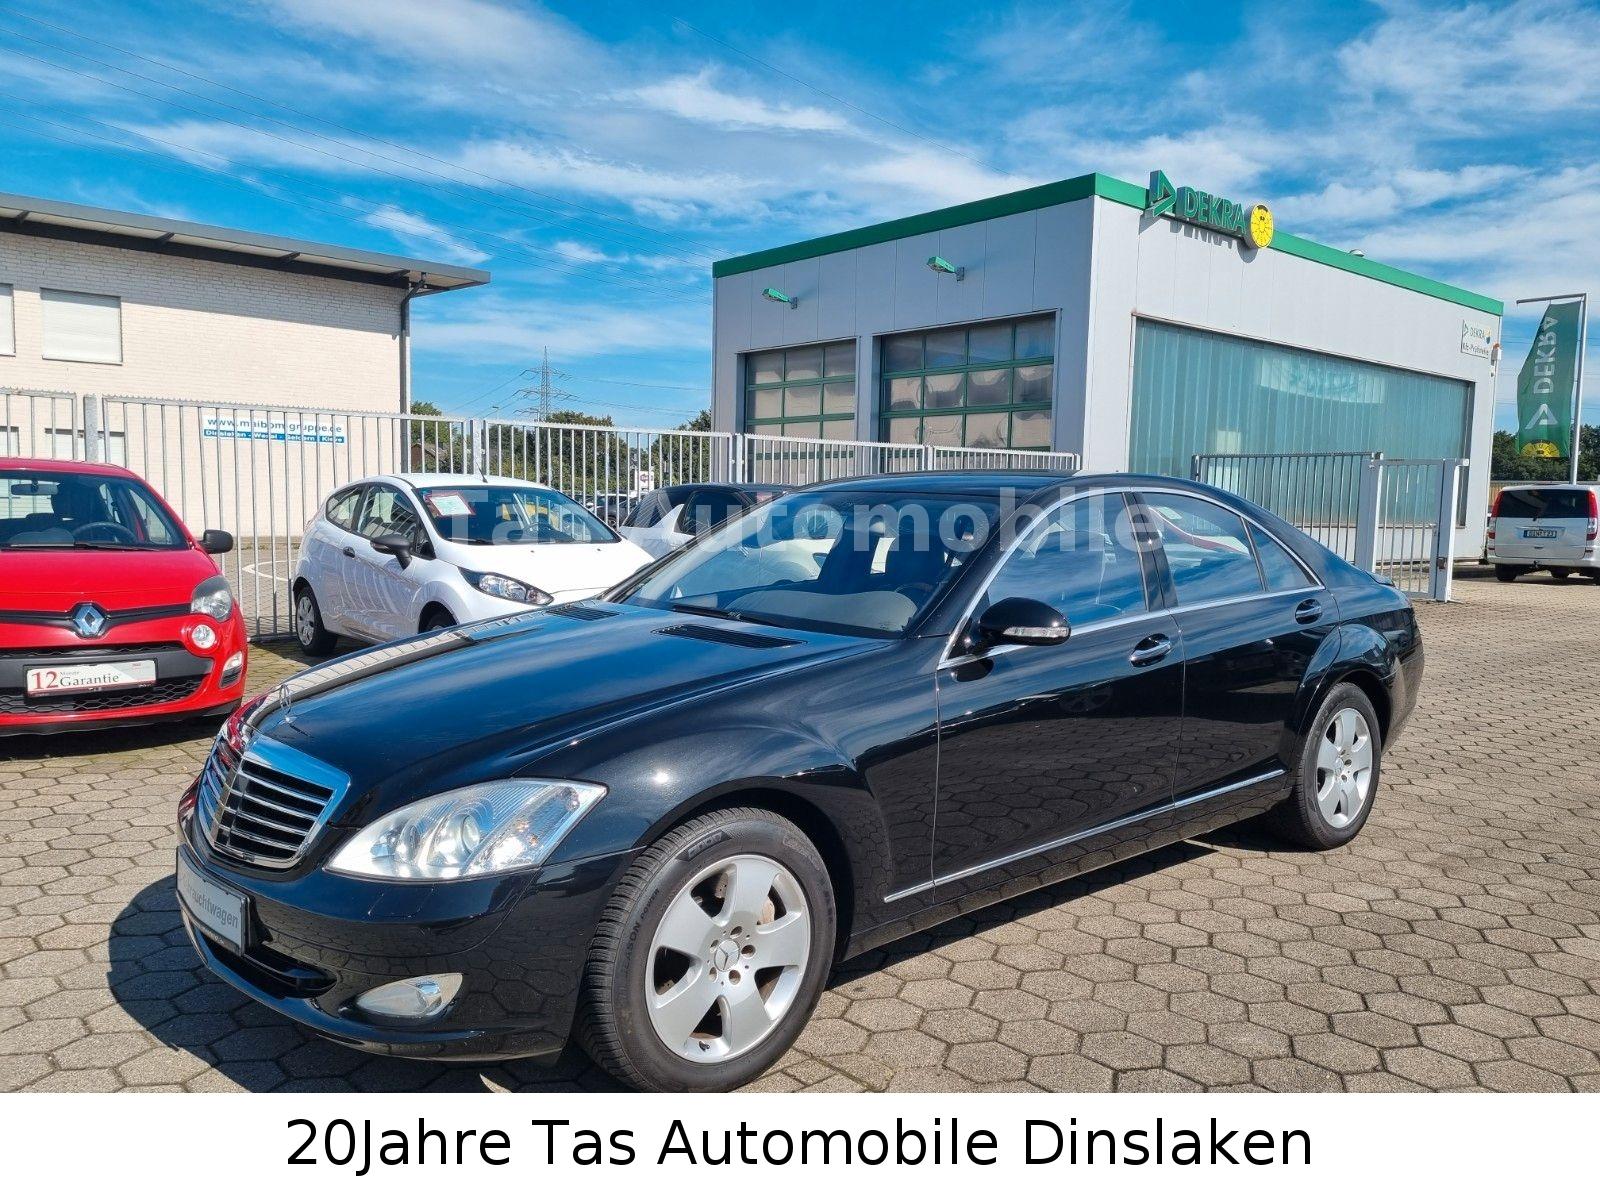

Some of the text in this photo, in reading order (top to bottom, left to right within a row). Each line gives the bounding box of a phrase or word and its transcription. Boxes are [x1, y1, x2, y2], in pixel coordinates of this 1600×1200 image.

[1179, 187, 1246, 234] DEKRA
[1533, 316, 1558, 394] DEKRA
[32, 671, 119, 690] 12 Garantie
